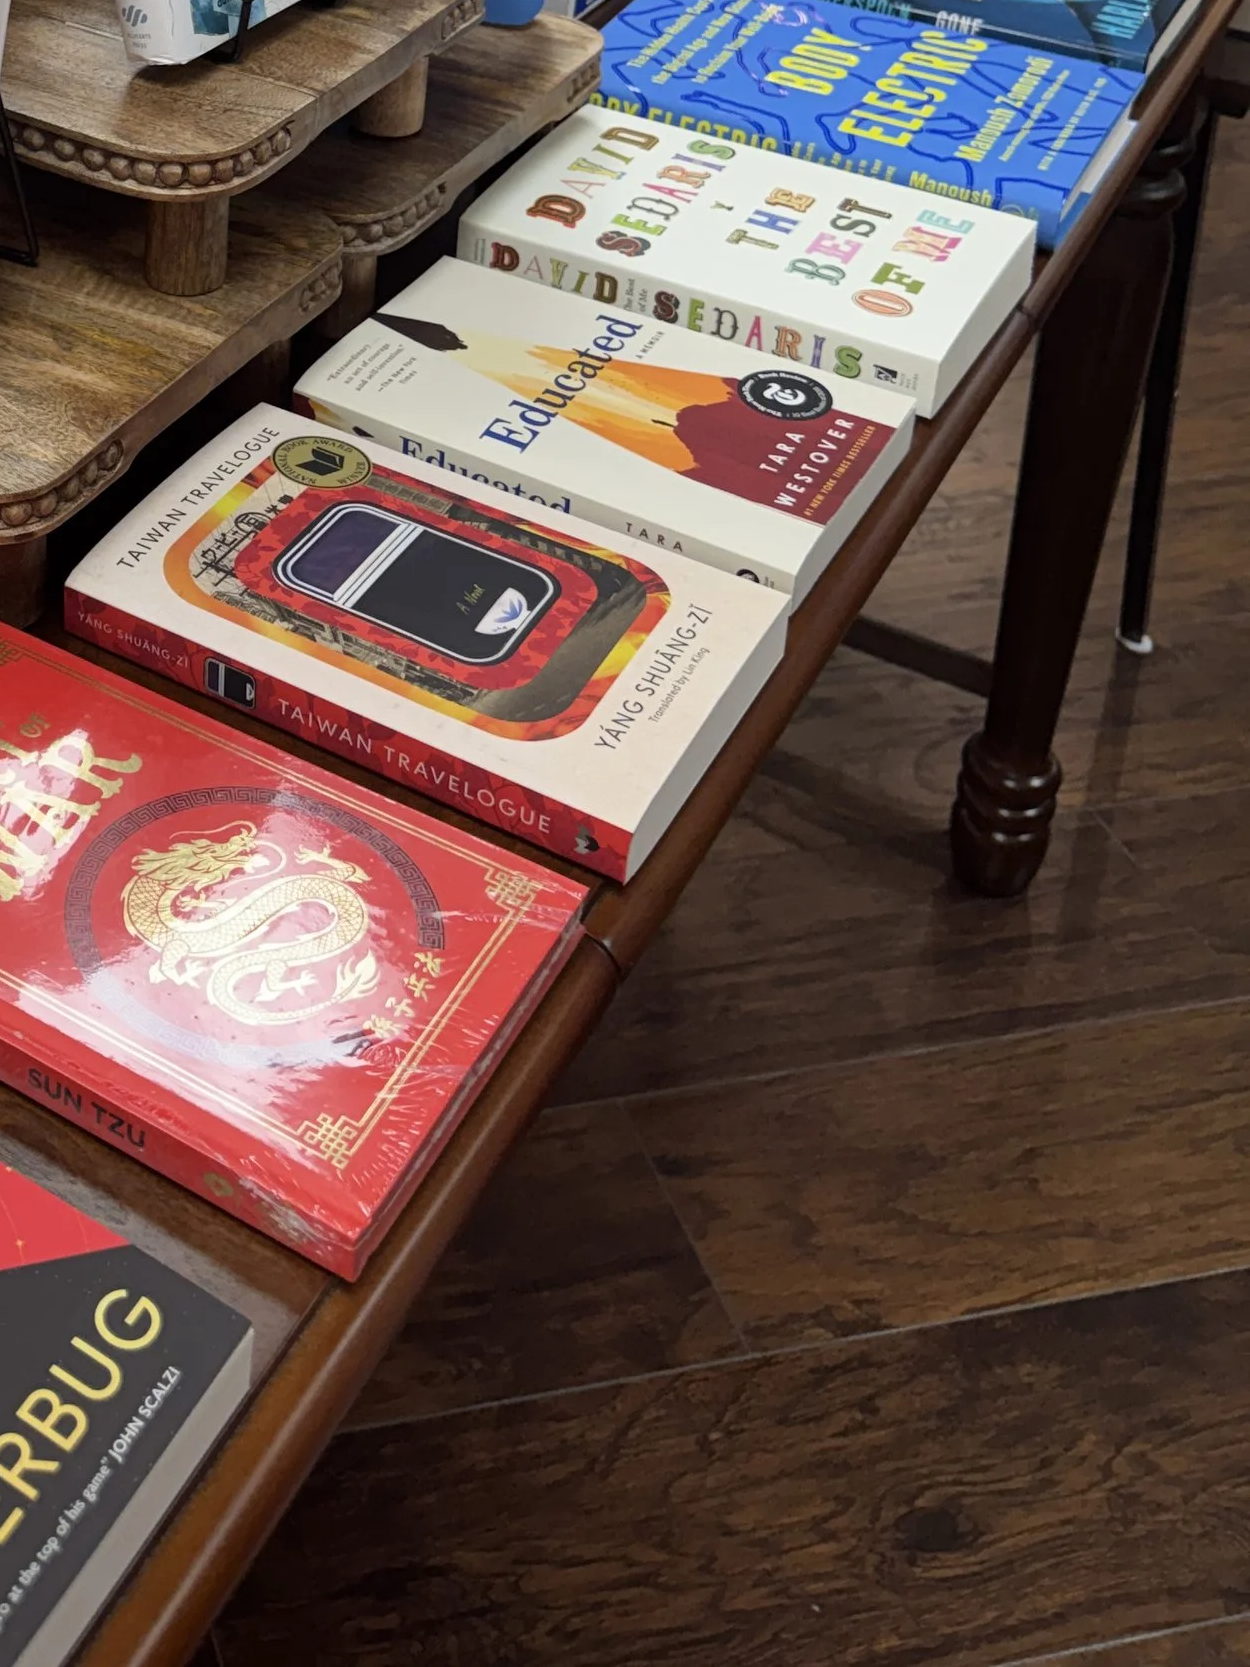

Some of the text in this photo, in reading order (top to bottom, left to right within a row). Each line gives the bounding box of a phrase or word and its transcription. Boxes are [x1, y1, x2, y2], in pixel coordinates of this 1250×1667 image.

[766, 27, 860, 96] BODY
[838, 30, 988, 146] ELECTRIC
[954, 108, 1017, 162] Manoush
[994, 55, 1054, 108] Zomorodi
[526, 126, 660, 229] DAVID
[596, 138, 736, 259] SEDARIS
[725, 187, 816, 252] THE
[785, 198, 892, 287] BEST
[852, 209, 975, 318] OF ME
[480, 314, 642, 454] Educated
[116, 426, 280, 569] TAIWAN TRAVELOGUE
[759, 432, 805, 473] TARA
[774, 418, 854, 506] WESTOVER
[18, 712, 54, 741] OF
[595, 693, 643, 751] YÁNG
[109, 1364, 182, 1463] JOHN SCALZI
